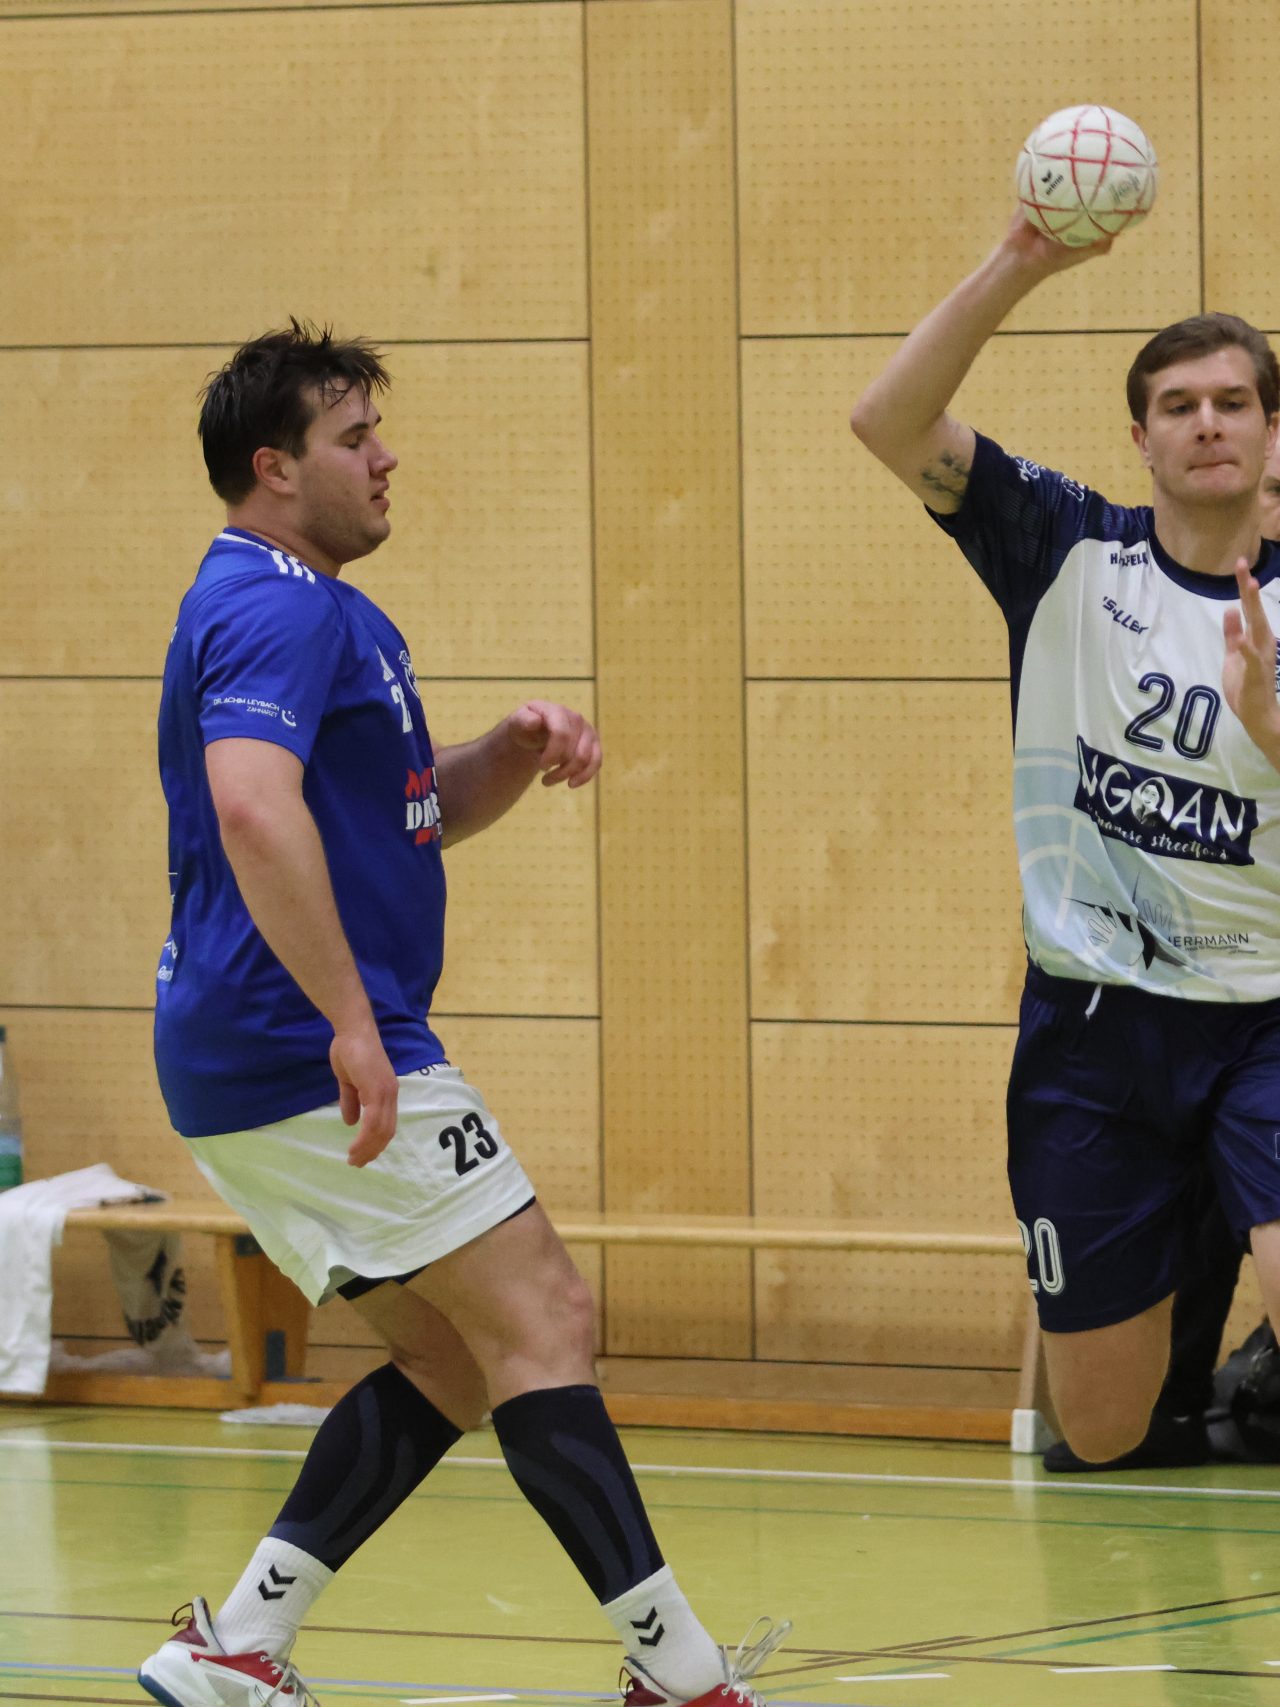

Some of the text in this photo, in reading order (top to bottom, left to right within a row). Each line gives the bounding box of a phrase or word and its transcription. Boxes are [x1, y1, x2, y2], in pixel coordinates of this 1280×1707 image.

[247, 698, 280, 712] LEYBACH
[1124, 672, 1221, 760] 20
[1076, 739, 1246, 842] NGOAN
[438, 1112, 498, 1177] 23
